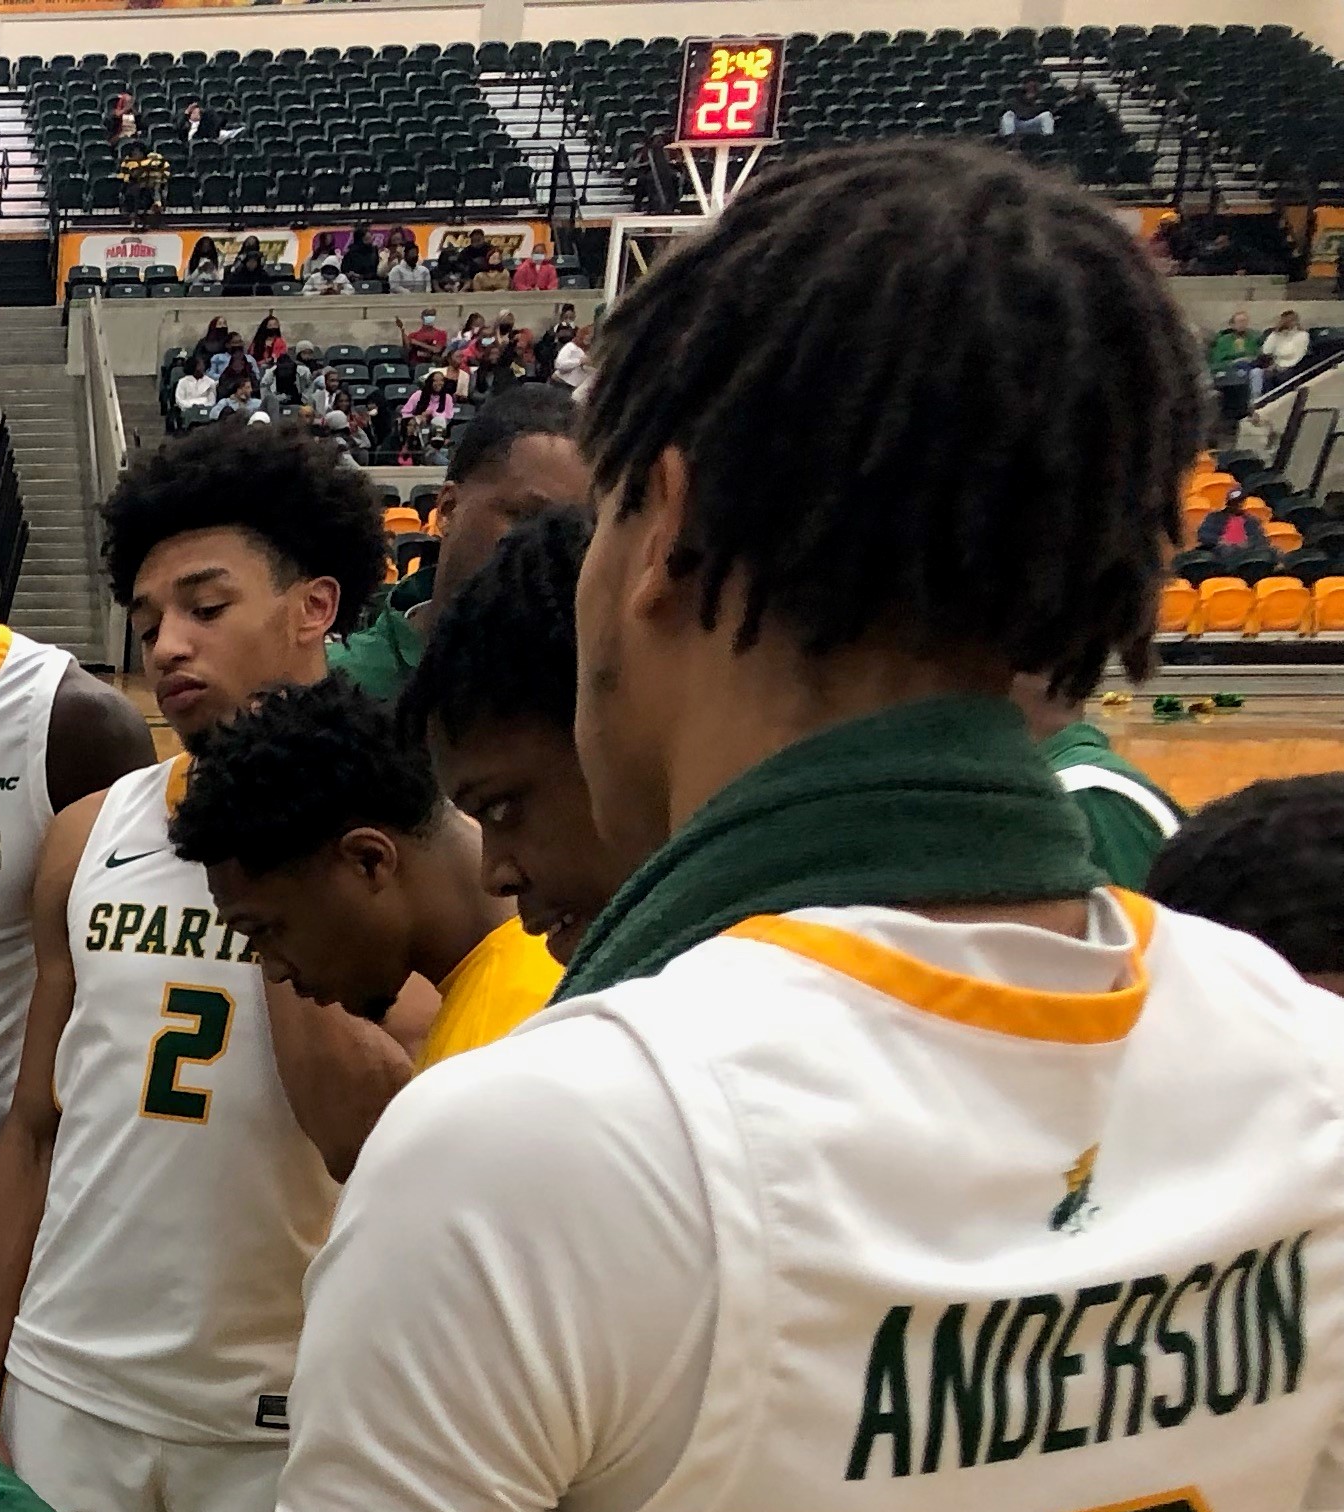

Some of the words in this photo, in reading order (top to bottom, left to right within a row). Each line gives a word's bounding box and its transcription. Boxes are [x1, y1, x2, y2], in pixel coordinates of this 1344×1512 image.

[710, 48, 772, 79] 3:42
[696, 80, 758, 131] 22
[86, 902, 263, 965] SPART
[139, 981, 236, 1125] 2
[845, 1230, 1312, 1482] ANDERSON
